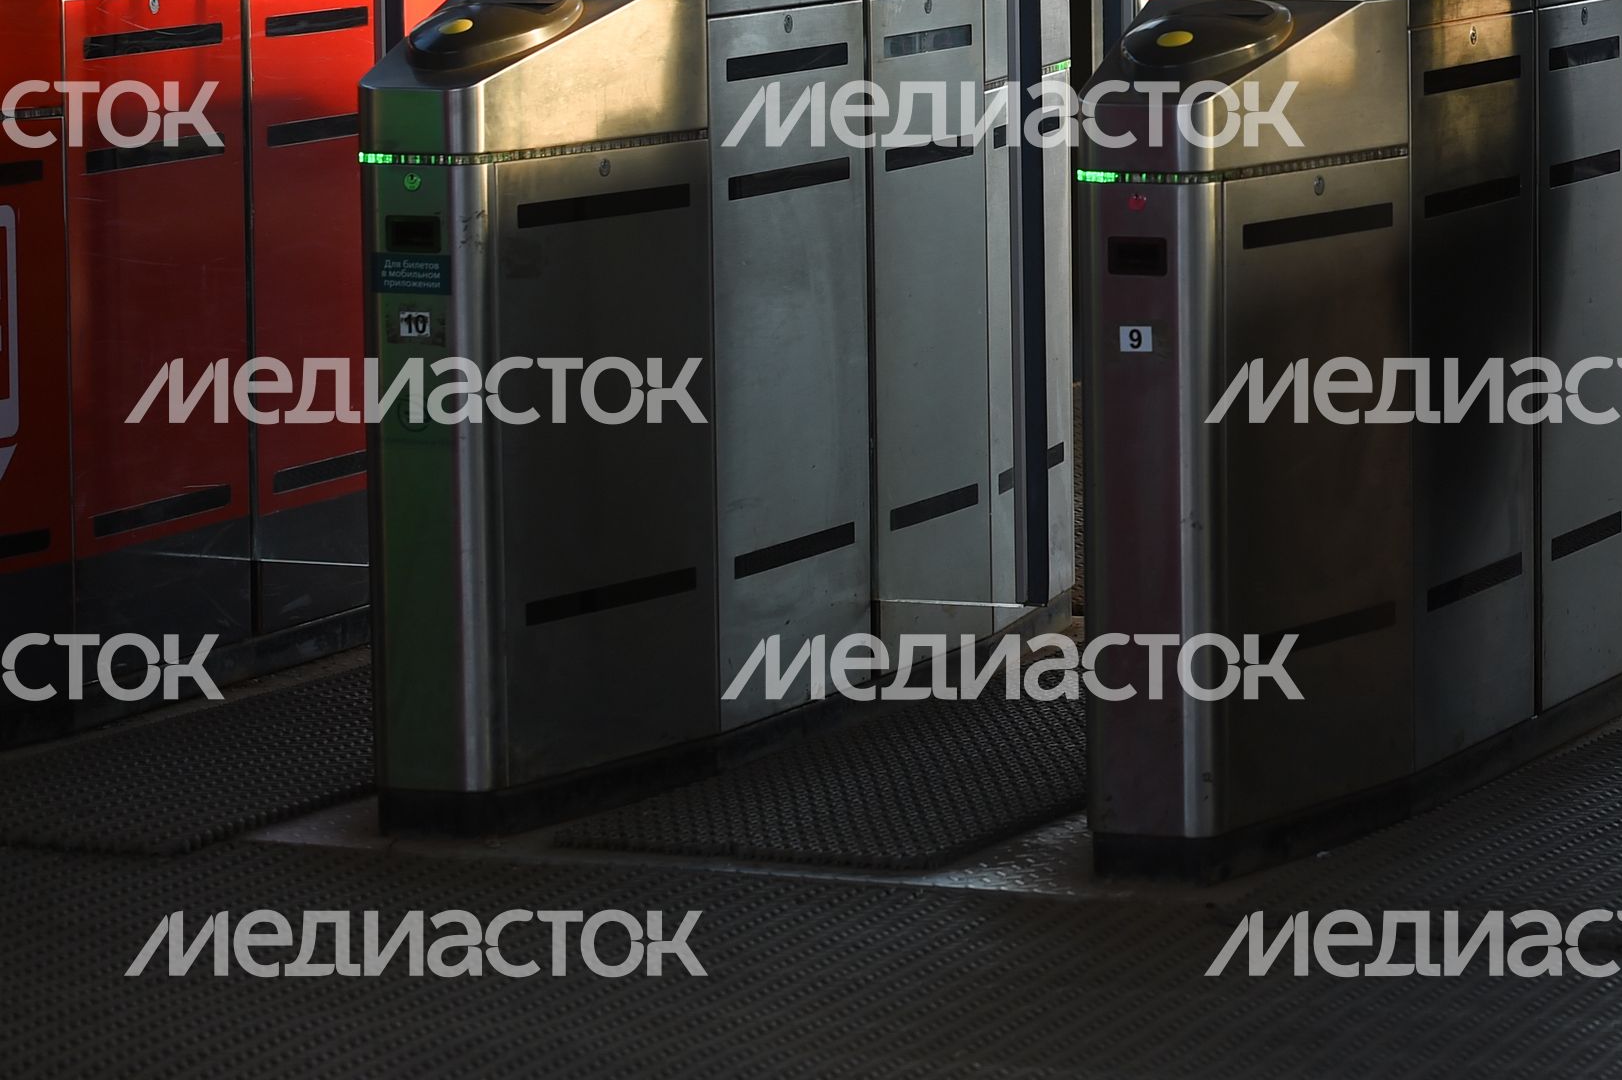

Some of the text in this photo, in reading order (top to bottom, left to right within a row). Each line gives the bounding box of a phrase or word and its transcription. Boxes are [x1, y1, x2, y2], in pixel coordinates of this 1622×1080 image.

[384, 260, 439, 270] Для билетов
[389, 269, 440, 278] мобильном
[384, 279, 440, 288] приложении
[405, 314, 428, 334] 10
[1129, 328, 1143, 349] 9
